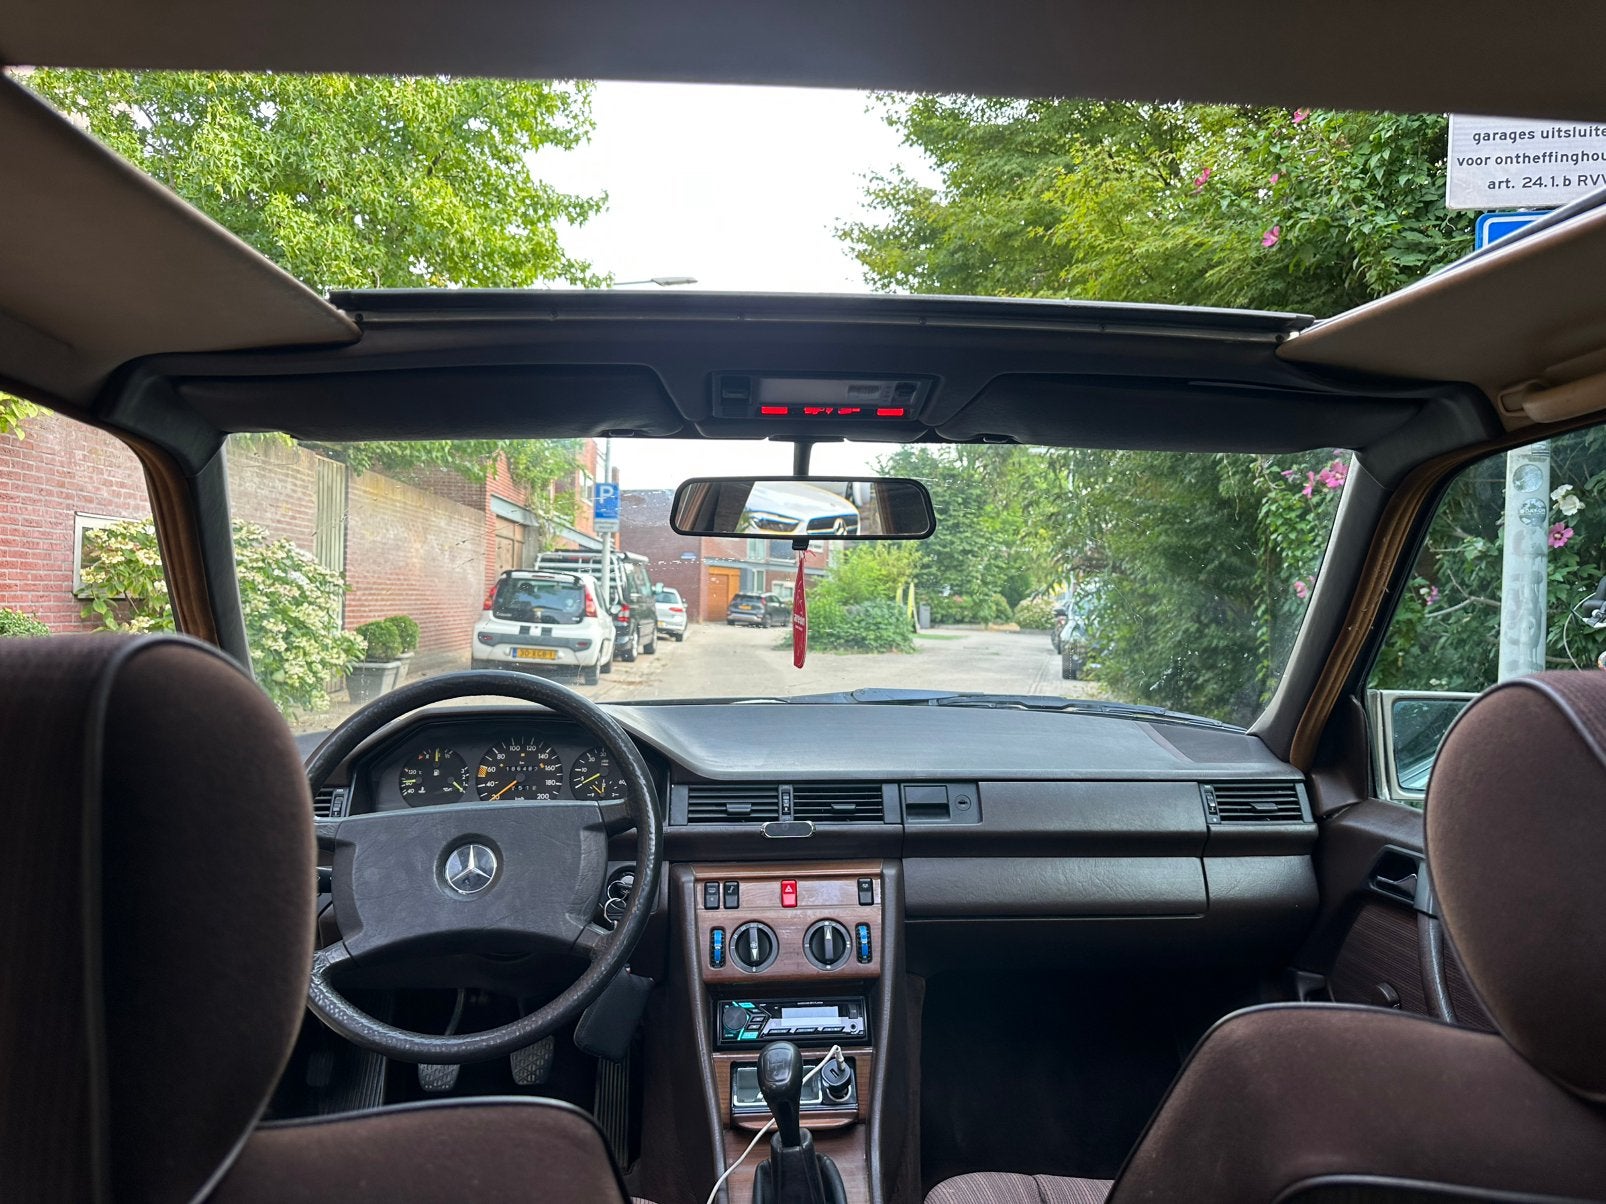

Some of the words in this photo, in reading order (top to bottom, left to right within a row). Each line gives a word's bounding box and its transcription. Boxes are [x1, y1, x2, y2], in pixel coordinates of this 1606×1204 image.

[1473, 130, 1535, 144] garages
[1457, 156, 1491, 167] voor
[1487, 178, 1515, 190] art.
[599, 485, 614, 504] P
